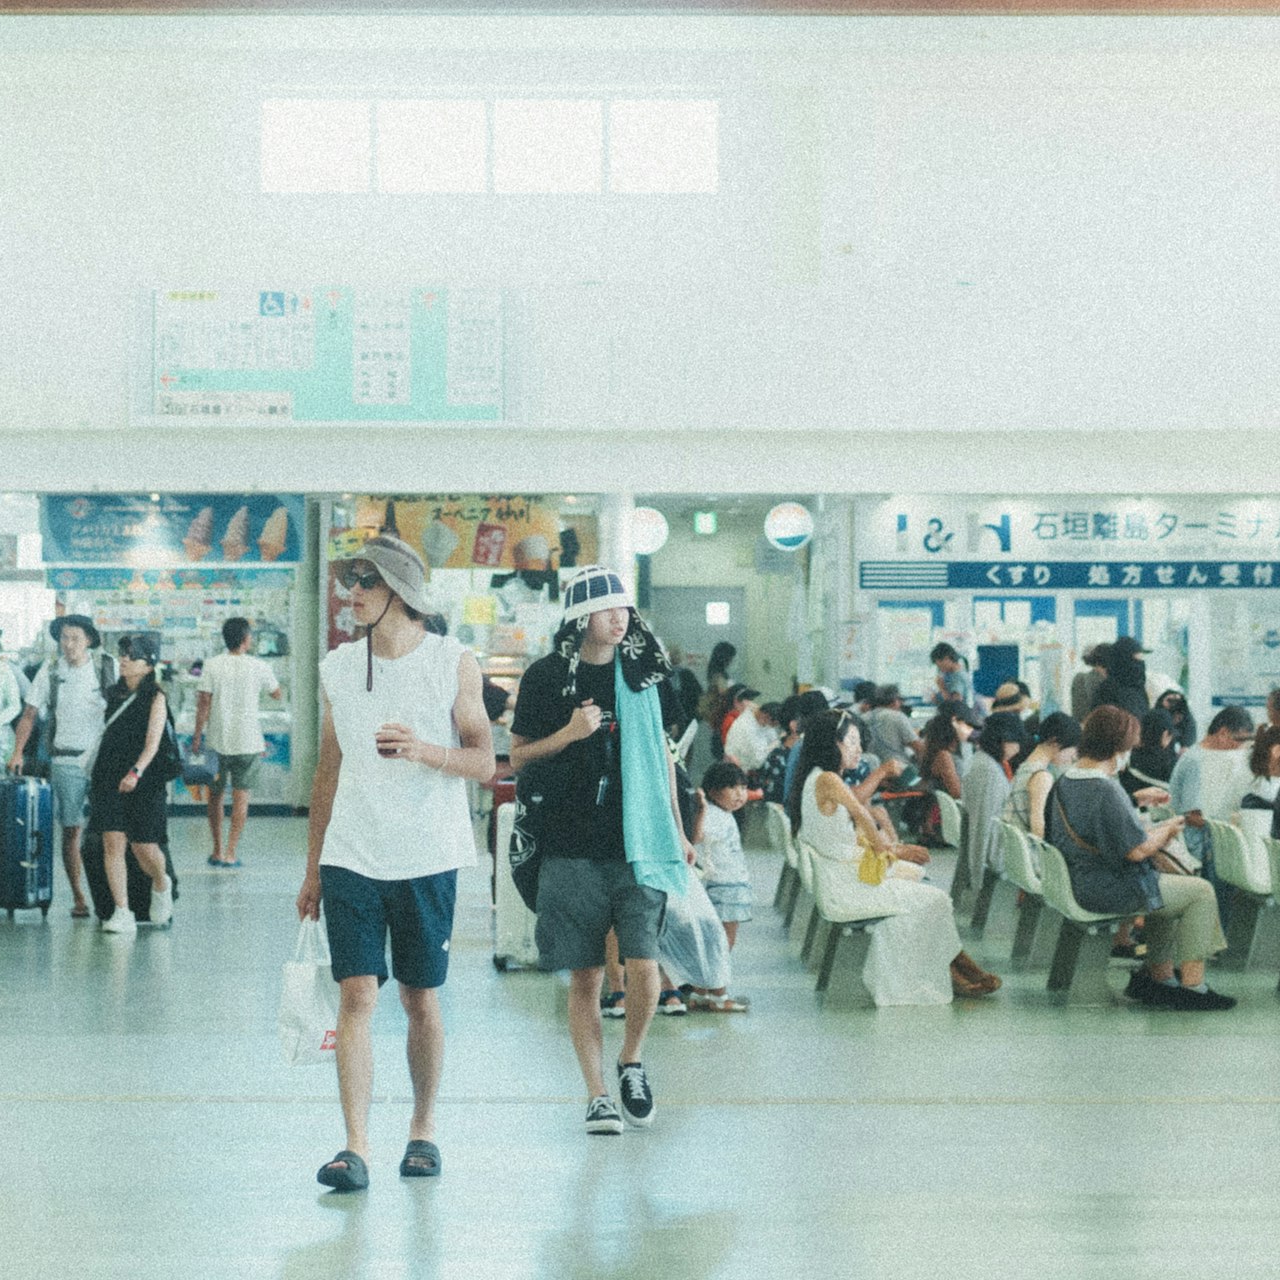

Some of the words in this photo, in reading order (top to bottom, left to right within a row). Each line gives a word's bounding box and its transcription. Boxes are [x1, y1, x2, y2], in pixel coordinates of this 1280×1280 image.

[985, 564, 1052, 586] くすり
[1087, 563, 1274, 587] 処方せん受付
